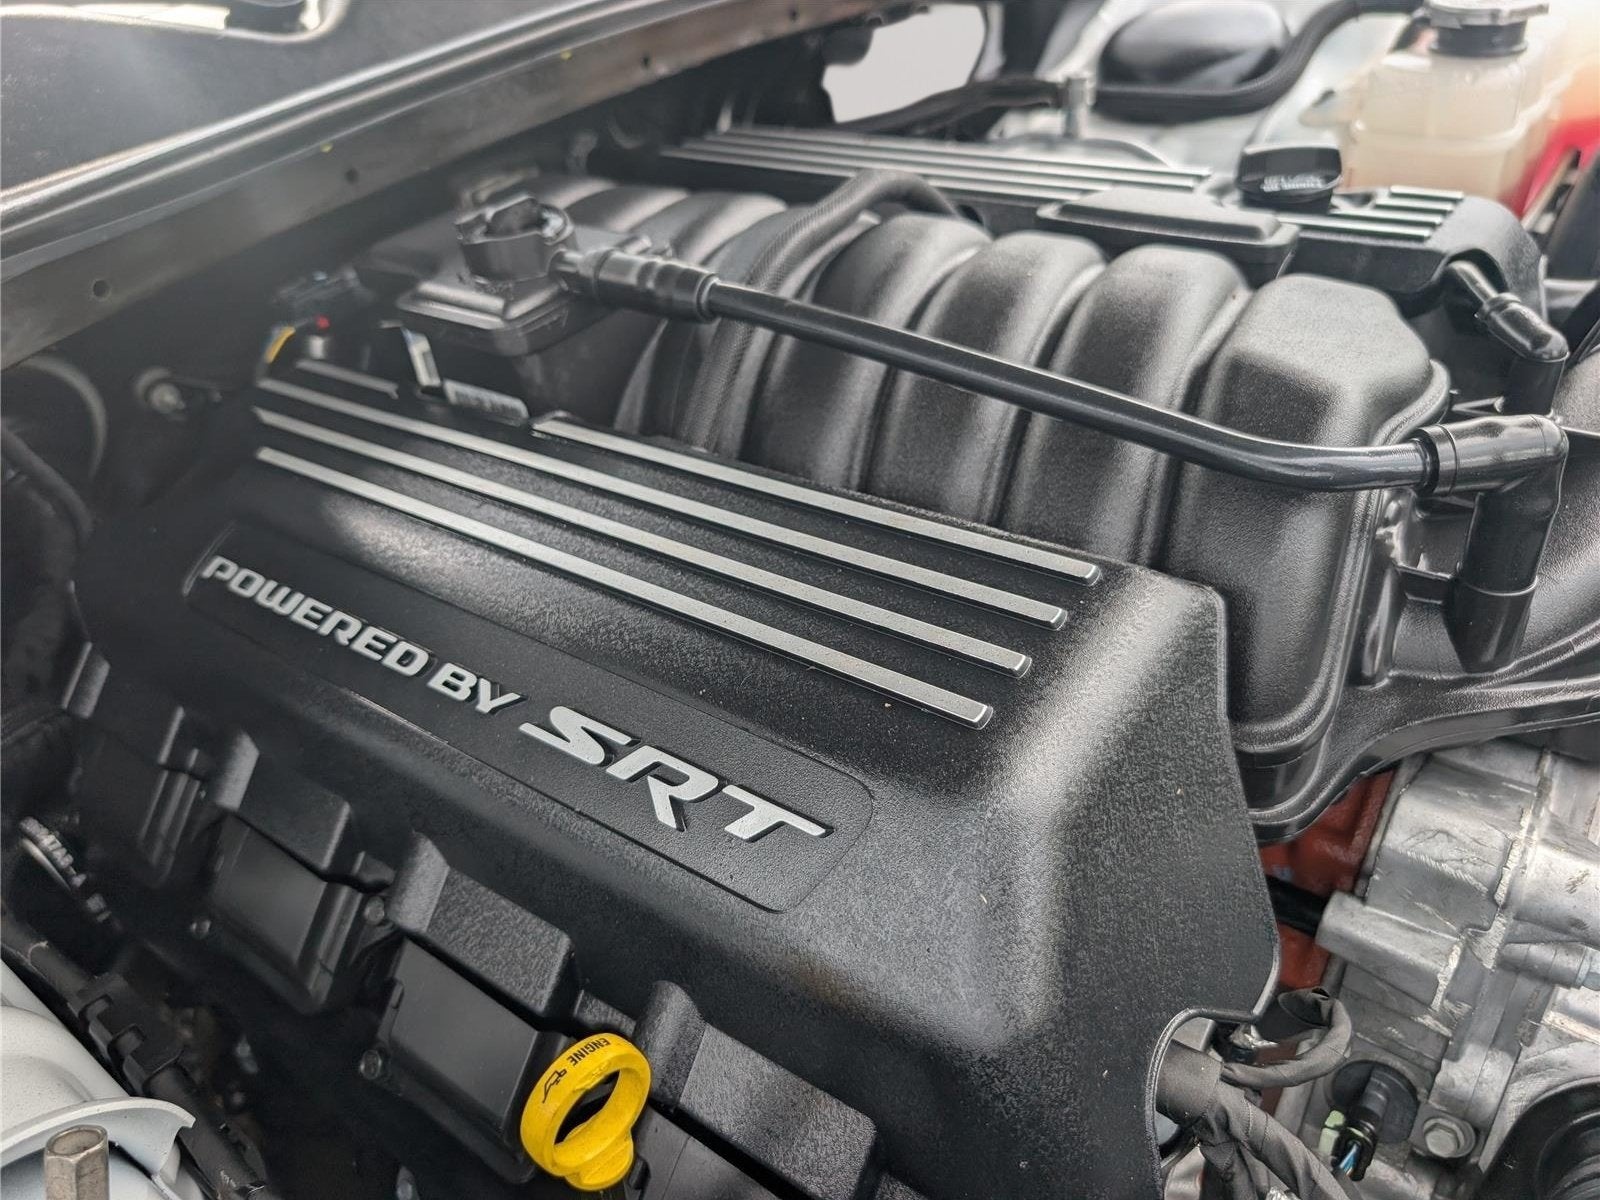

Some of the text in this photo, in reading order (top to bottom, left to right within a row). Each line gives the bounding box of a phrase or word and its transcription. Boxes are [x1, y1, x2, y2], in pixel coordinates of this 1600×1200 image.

[202, 555, 827, 840] POWERED BY SRT
[566, 1037, 611, 1067] ENGINE
